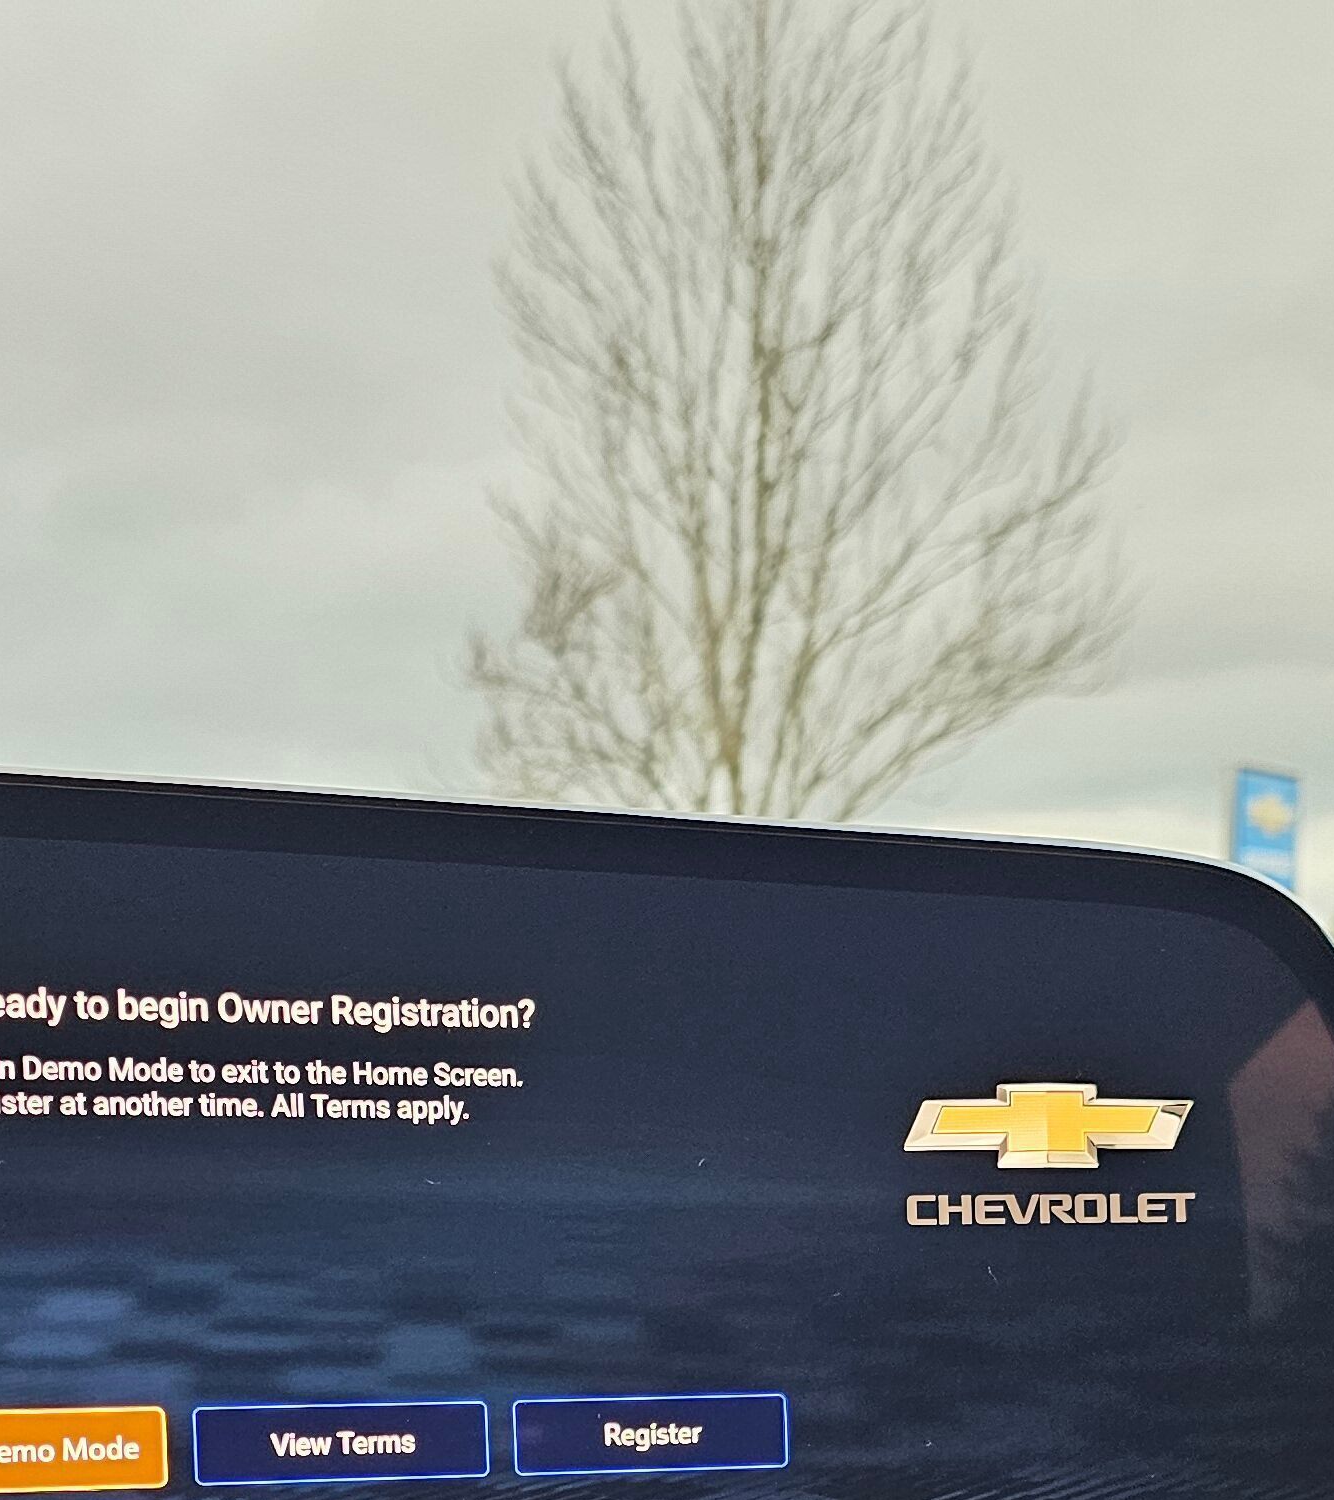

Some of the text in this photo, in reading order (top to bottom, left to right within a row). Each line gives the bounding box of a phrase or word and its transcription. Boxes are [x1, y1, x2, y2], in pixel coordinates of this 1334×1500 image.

[73, 990, 109, 1020] to
[117, 988, 209, 1029] begin
[217, 991, 323, 1025] Owner
[331, 994, 536, 1034] Registration?
[22, 1056, 101, 1081] Demo
[109, 1057, 184, 1083] Mode
[189, 1060, 215, 1084] to
[222, 1060, 268, 1084] exit
[273, 1061, 300, 1085] to
[306, 1060, 347, 1085] the
[353, 1062, 428, 1086] Home
[434, 1062, 523, 1088] Screen.
[60, 1092, 88, 1115] at
[93, 1091, 193, 1117] another
[199, 1093, 264, 1118] time.
[271, 1093, 304, 1118] All
[311, 1094, 390, 1119] Terms
[397, 1095, 470, 1126] apply.
[906, 1192, 1196, 1226] CHEVROLET
[62, 1434, 140, 1461] Mode
[270, 1430, 416, 1457] View Terms
[603, 1422, 703, 1452] Register
